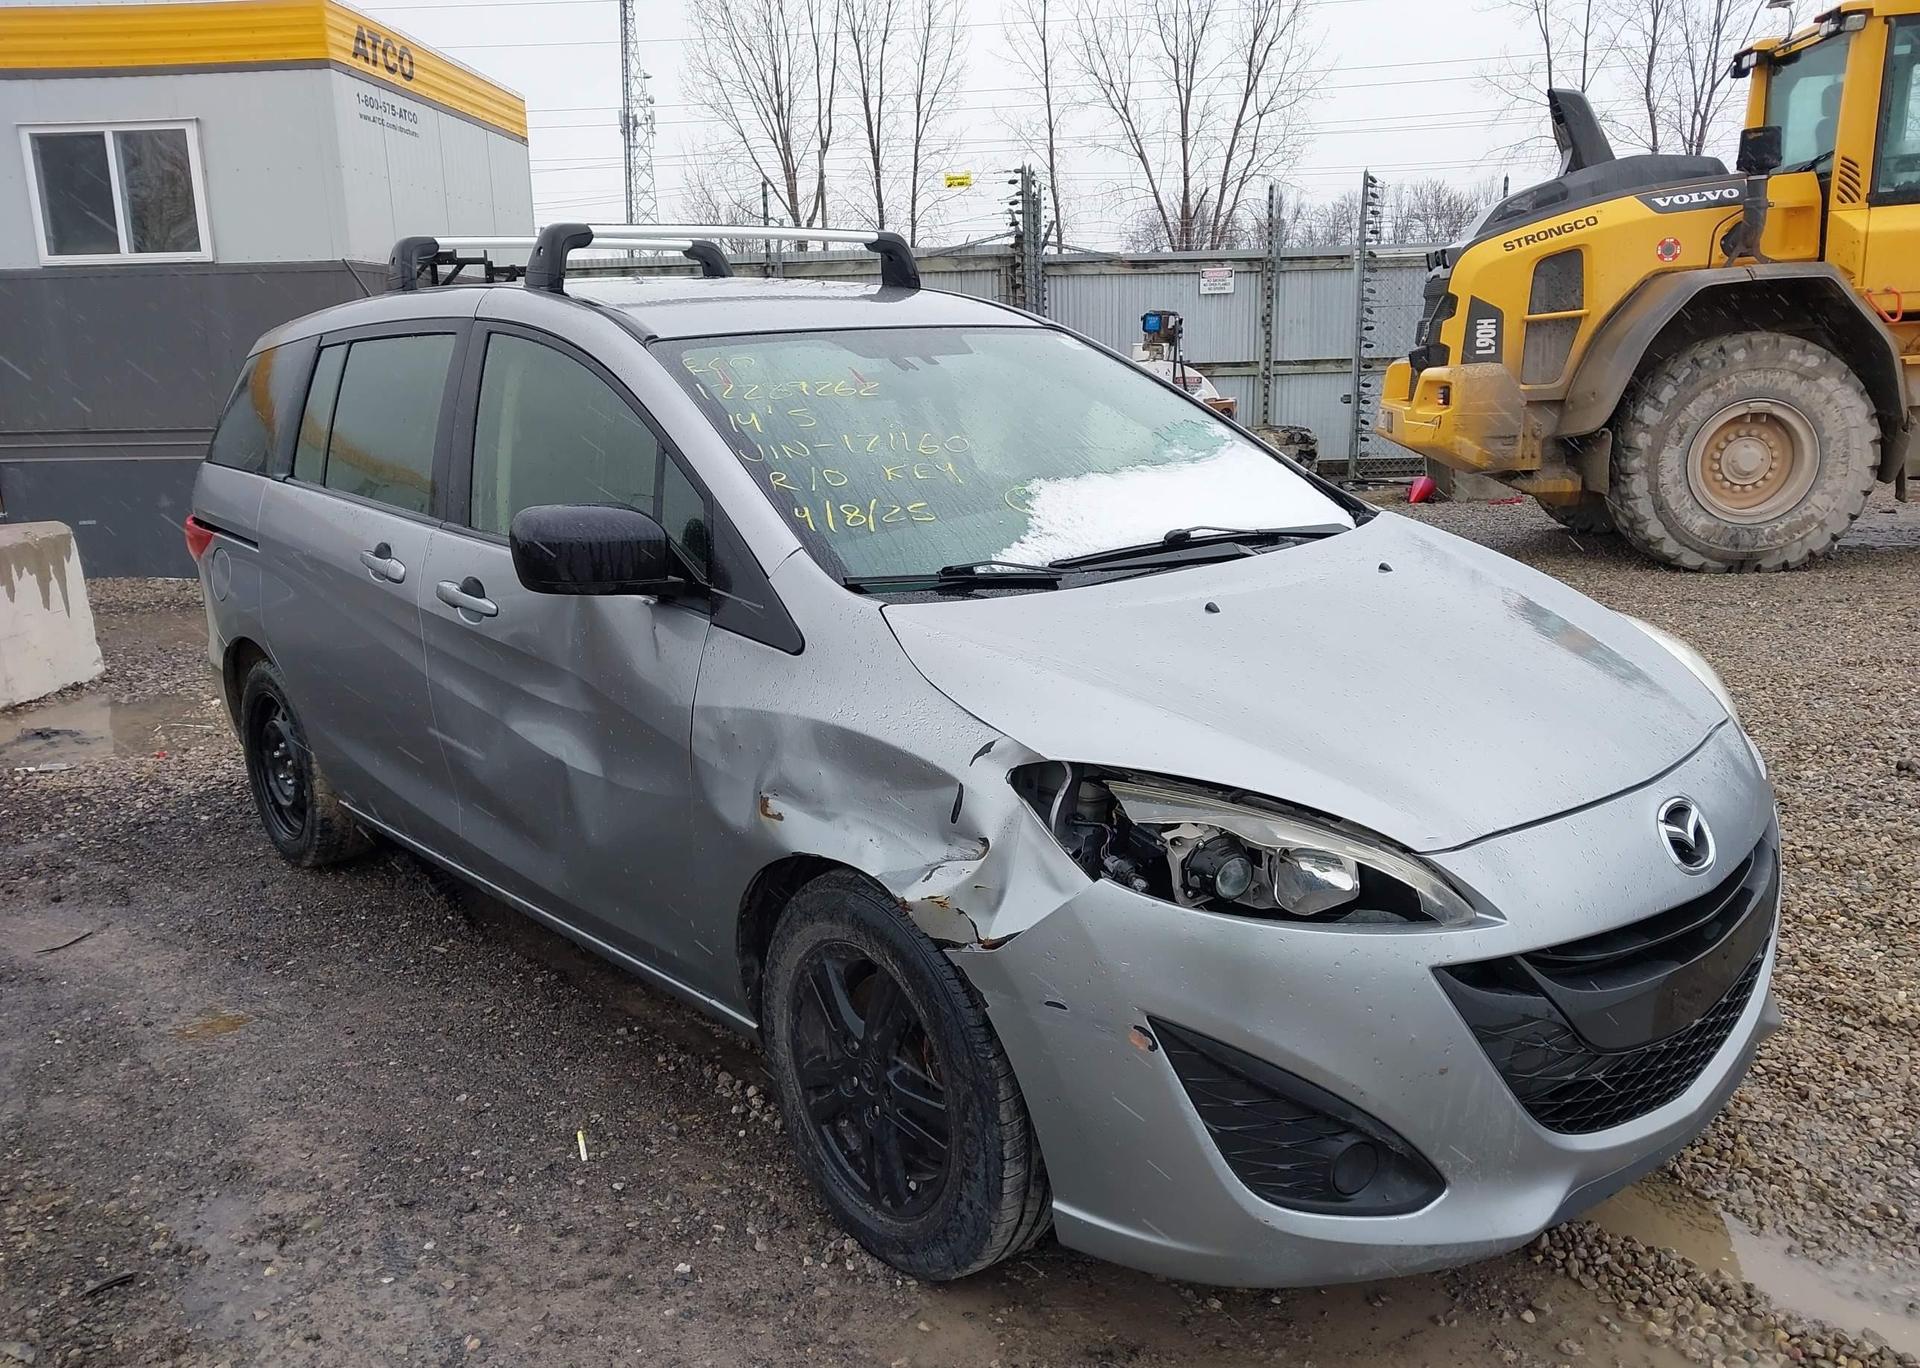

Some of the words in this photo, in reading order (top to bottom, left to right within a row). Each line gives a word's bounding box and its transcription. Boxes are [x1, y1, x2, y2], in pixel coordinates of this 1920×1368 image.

[351, 24, 415, 82] ATCO
[356, 92, 418, 125] 1-800-575-ATCO
[1651, 188, 1740, 207] VOLVO
[1503, 215, 1599, 252] STRONGCO
[1475, 318, 1497, 355] L90H
[880, 462, 966, 485] KEY
[794, 498, 937, 534] 4/8/25
